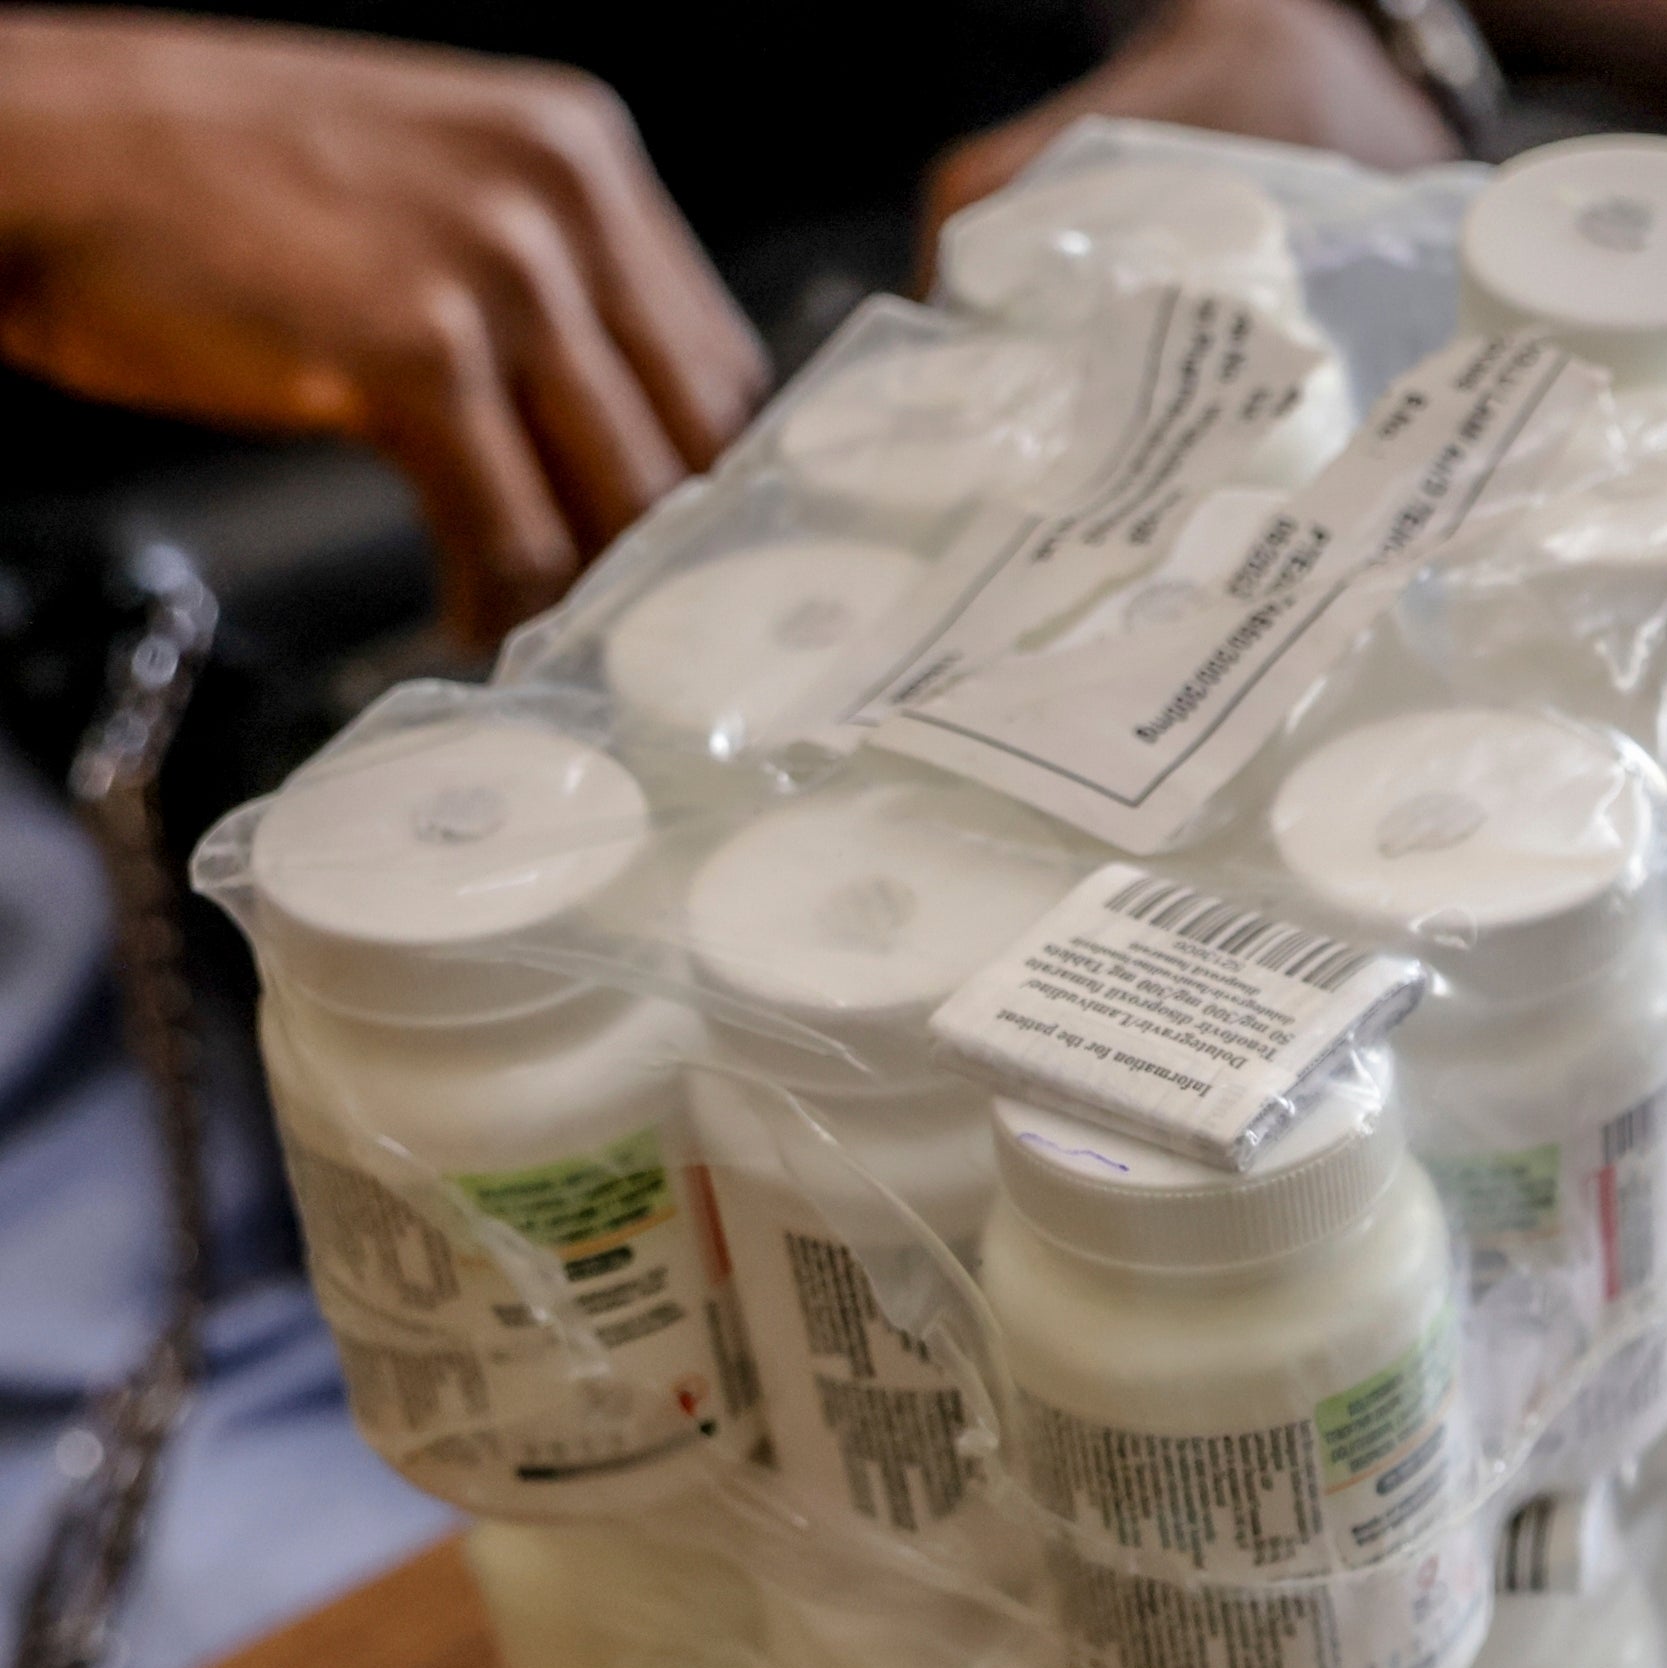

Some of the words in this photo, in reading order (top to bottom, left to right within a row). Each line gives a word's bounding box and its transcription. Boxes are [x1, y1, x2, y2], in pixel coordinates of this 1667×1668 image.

[996, 1009, 1059, 1037] patient
[1056, 1030, 1085, 1048] the
[1083, 1041, 1113, 1060] for
[1112, 1051, 1212, 1098] Information
